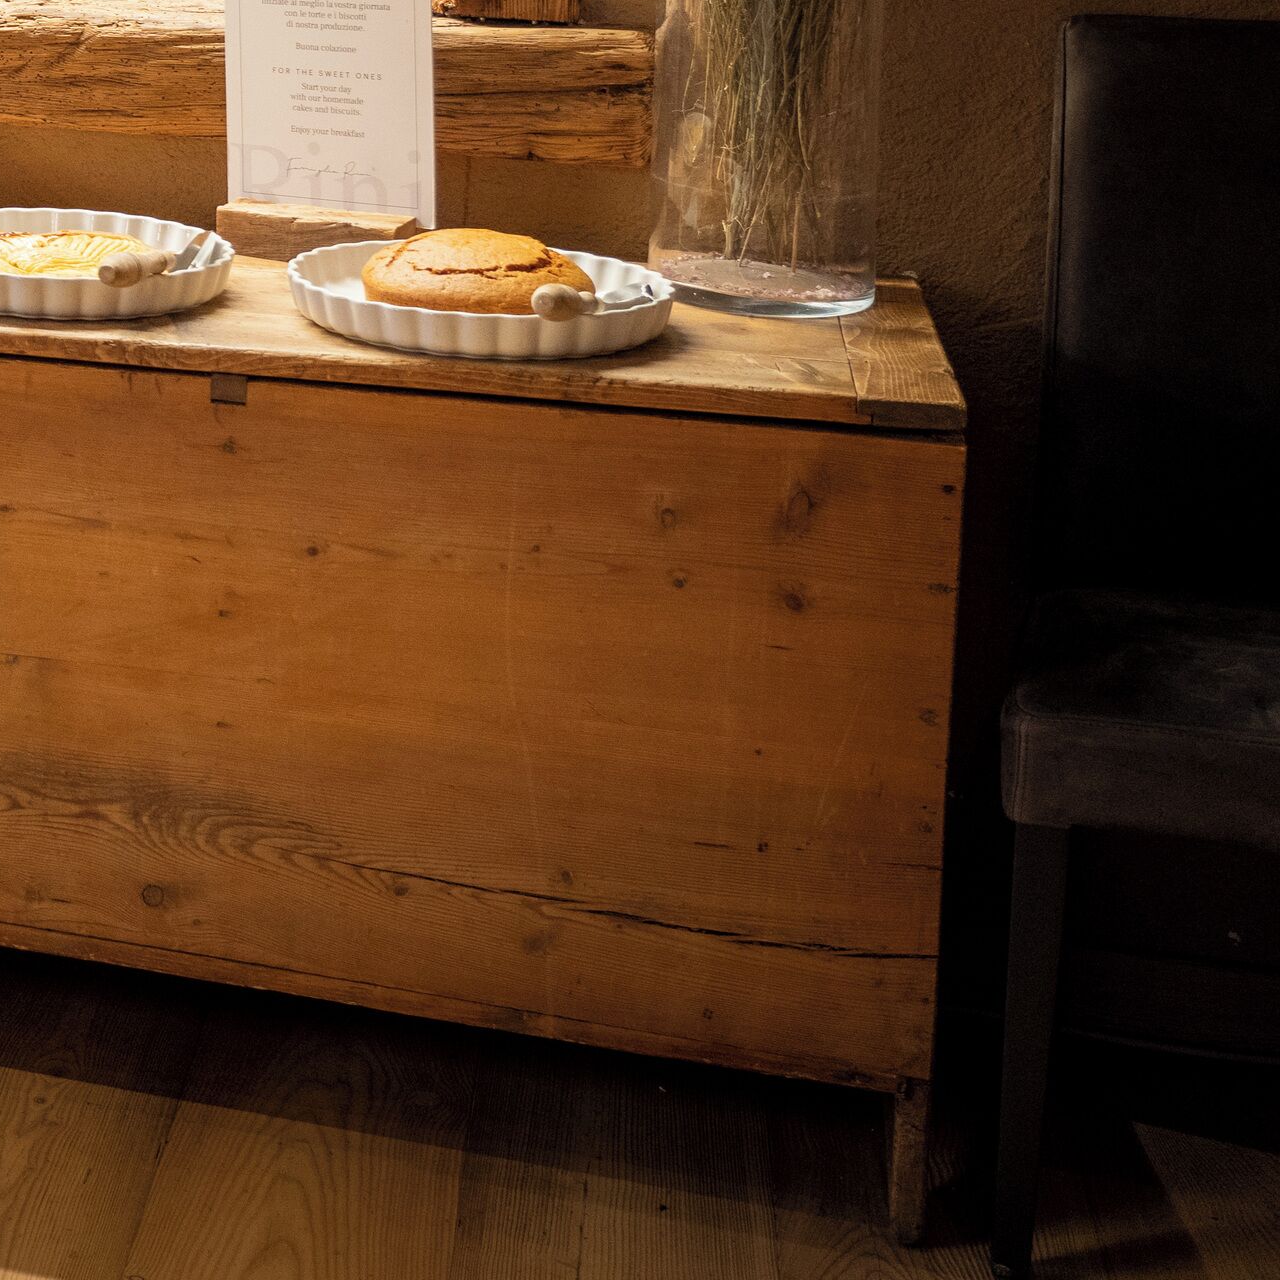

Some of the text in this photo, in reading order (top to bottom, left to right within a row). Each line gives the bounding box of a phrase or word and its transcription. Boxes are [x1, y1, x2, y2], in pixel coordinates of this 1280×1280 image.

[300, 0, 325, 9] meglio
[333, 1, 357, 9] vostra
[358, 2, 391, 11] giornata
[308, 10, 326, 18] torte
[338, 12, 367, 21] biscotti
[295, 42, 357, 53] Buona colazione
[296, 68, 313, 76] THE
[318, 69, 350, 78] SWEET
[355, 72, 382, 81] ONES
[301, 82, 351, 95] Start your day
[290, 92, 306, 101] with
[322, 95, 364, 105] homemade
[292, 103, 313, 113] cakes
[314, 106, 329, 114] and
[290, 124, 365, 138] Enjoy your breakfast
